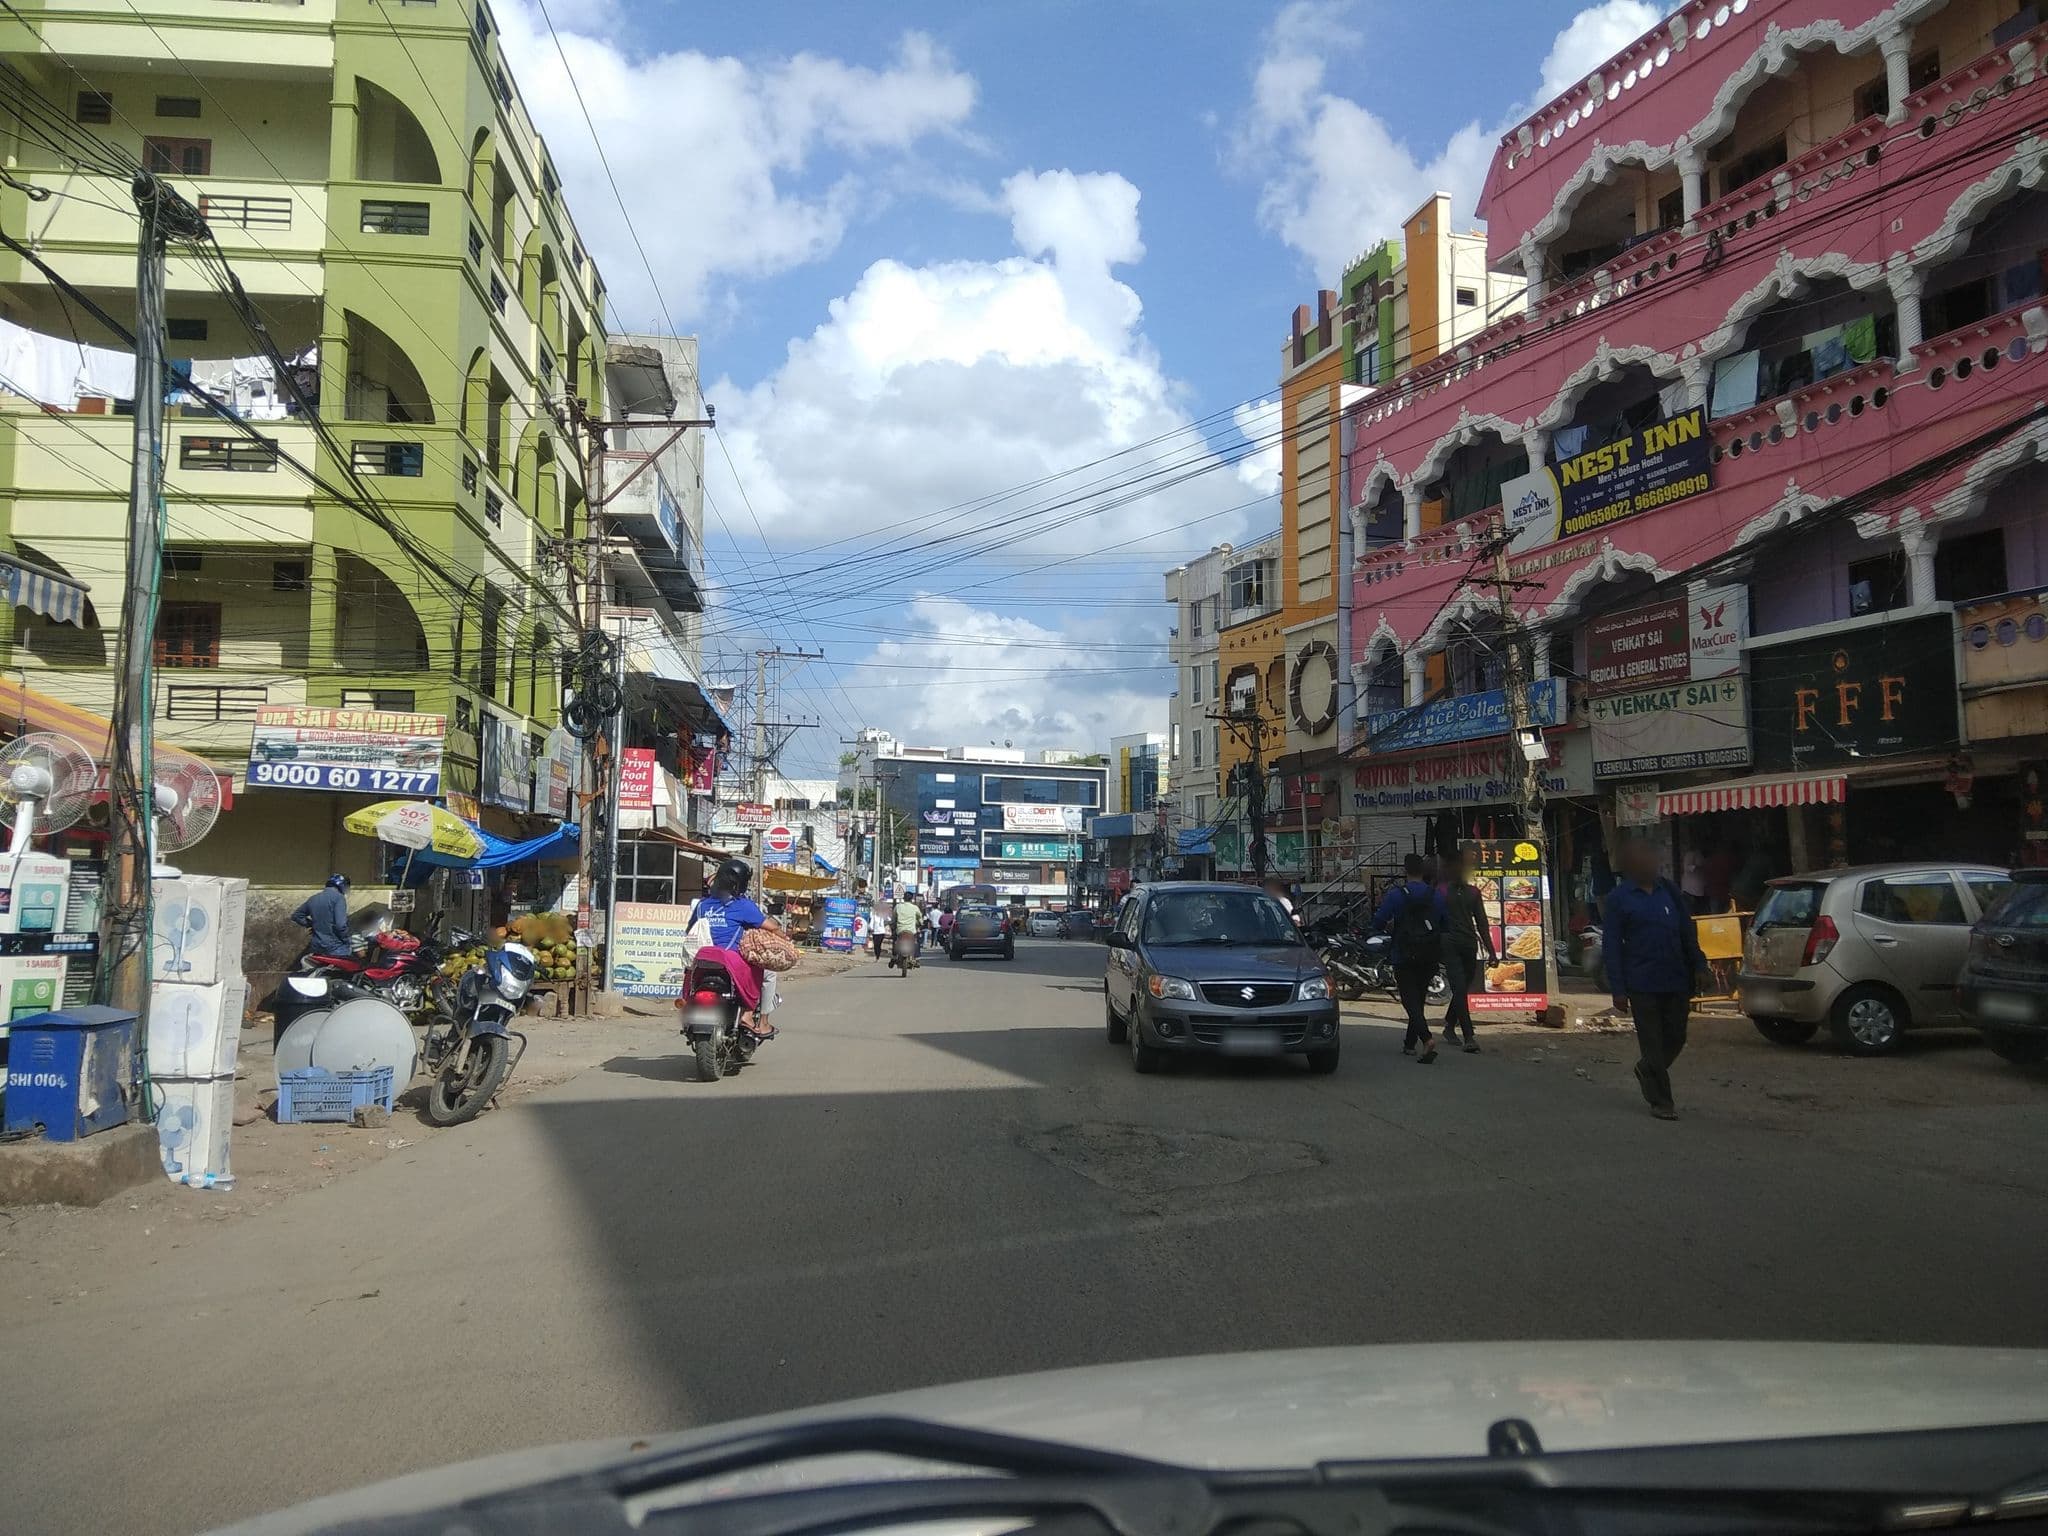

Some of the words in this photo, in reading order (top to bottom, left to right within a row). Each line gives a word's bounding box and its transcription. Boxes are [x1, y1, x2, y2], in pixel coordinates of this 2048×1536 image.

[1561, 437, 1634, 487] NEST
[1643, 410, 1702, 455] INN
[1597, 471, 1618, 485] Men's
[1618, 462, 1641, 478] Deluxe
[1641, 453, 1664, 470] Hostel
[1512, 503, 1532, 519] NEST
[1534, 496, 1551, 511] INN
[1565, 499, 1634, 534] 9000558822,
[1635, 473, 1709, 511] 9666999919
[1611, 635, 1646, 654] VENKAT
[1647, 630, 1663, 646] SAI
[1691, 632, 1737, 651] MaxCure
[1590, 665, 1619, 683] MEDICAL
[1619, 664, 1625, 677] &
[1626, 658, 1659, 678] GENERAL
[1659, 652, 1688, 671] STORES
[1610, 689, 1681, 717] VENKAT
[1686, 684, 1717, 706] SAI
[1794, 688, 1819, 730] F
[1835, 682, 1861, 726] F
[1879, 676, 1906, 720] F
[292, 709, 331, 727] SAI
[335, 711, 439, 736] SANDHYA
[1596, 763, 1602, 775] &
[1602, 761, 1632, 774] GENERAL
[1632, 758, 1659, 772] STORES
[1661, 752, 1696, 769] CHEMISTS
[1704, 748, 1747, 765] DRUGGISTS
[256, 764, 321, 785] 9000
[328, 768, 361, 788] 60
[369, 770, 432, 792] 1277
[621, 769, 648, 780] Foot
[620, 781, 649, 792] Wear
[1354, 793, 1376, 808] The
[1378, 788, 1435, 808] Complete
[1437, 783, 1481, 804] Family
[400, 807, 431, 823] 50%
[400, 819, 421, 828] OFF
[736, 814, 771, 822] FOOTWEAR
[1483, 869, 1505, 877] HOURS:
[1518, 869, 1527, 877] TO
[627, 907, 644, 920] SAI
[621, 926, 641, 936] MOTOR
[642, 927, 665, 937] DRIVING
[665, 928, 687, 938] SCHOO
[9, 1073, 32, 1087] SHI
